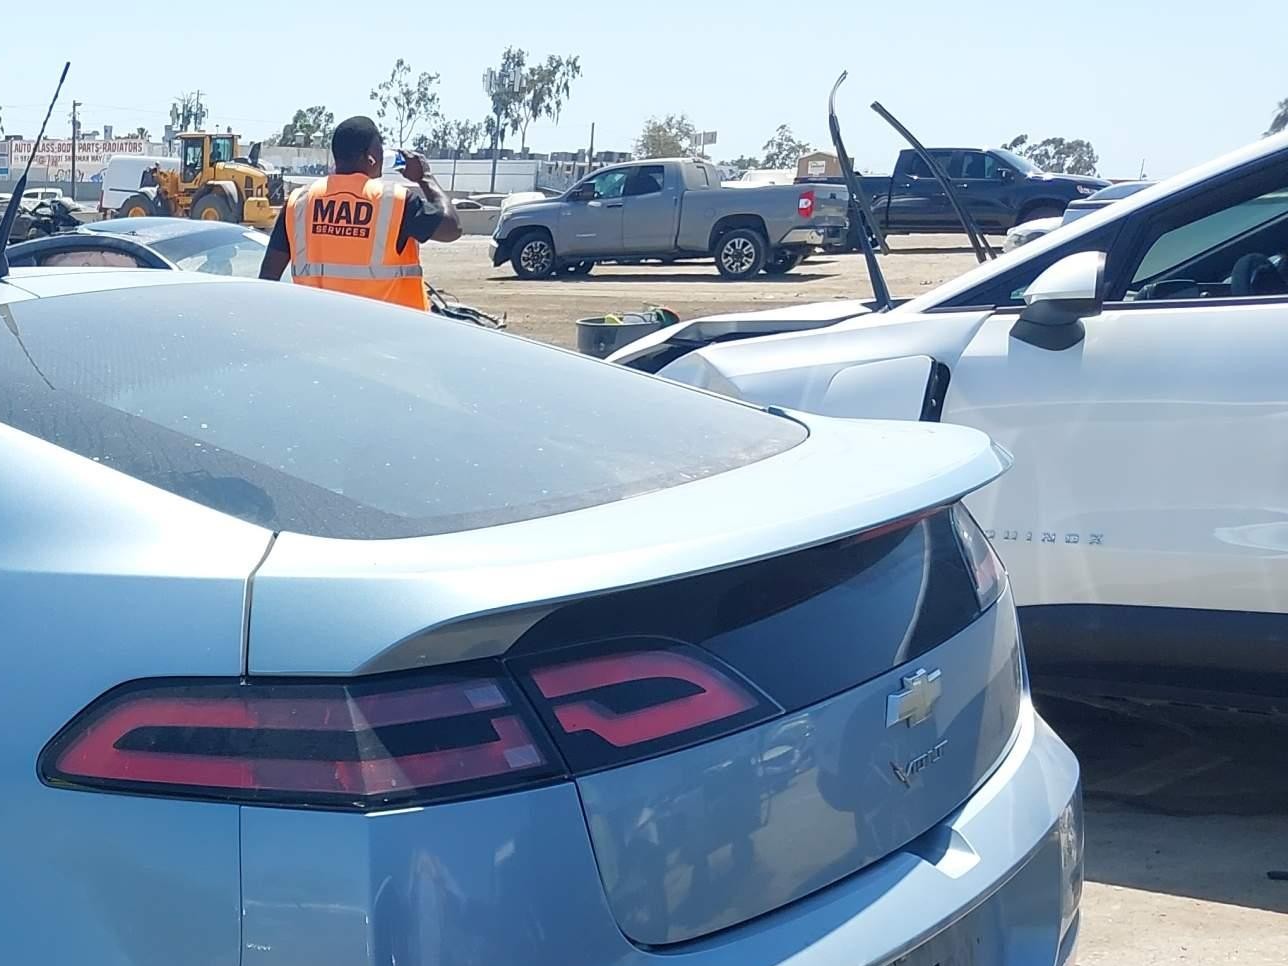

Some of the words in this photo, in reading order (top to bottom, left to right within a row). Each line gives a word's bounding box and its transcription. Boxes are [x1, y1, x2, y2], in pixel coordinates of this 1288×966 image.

[14, 143, 32, 153] AUTO
[34, 143, 73, 153] LASS-BOD
[313, 199, 373, 225] MAD
[315, 225, 367, 237] SERVICES
[985, 530, 1104, 545] QUINOX
